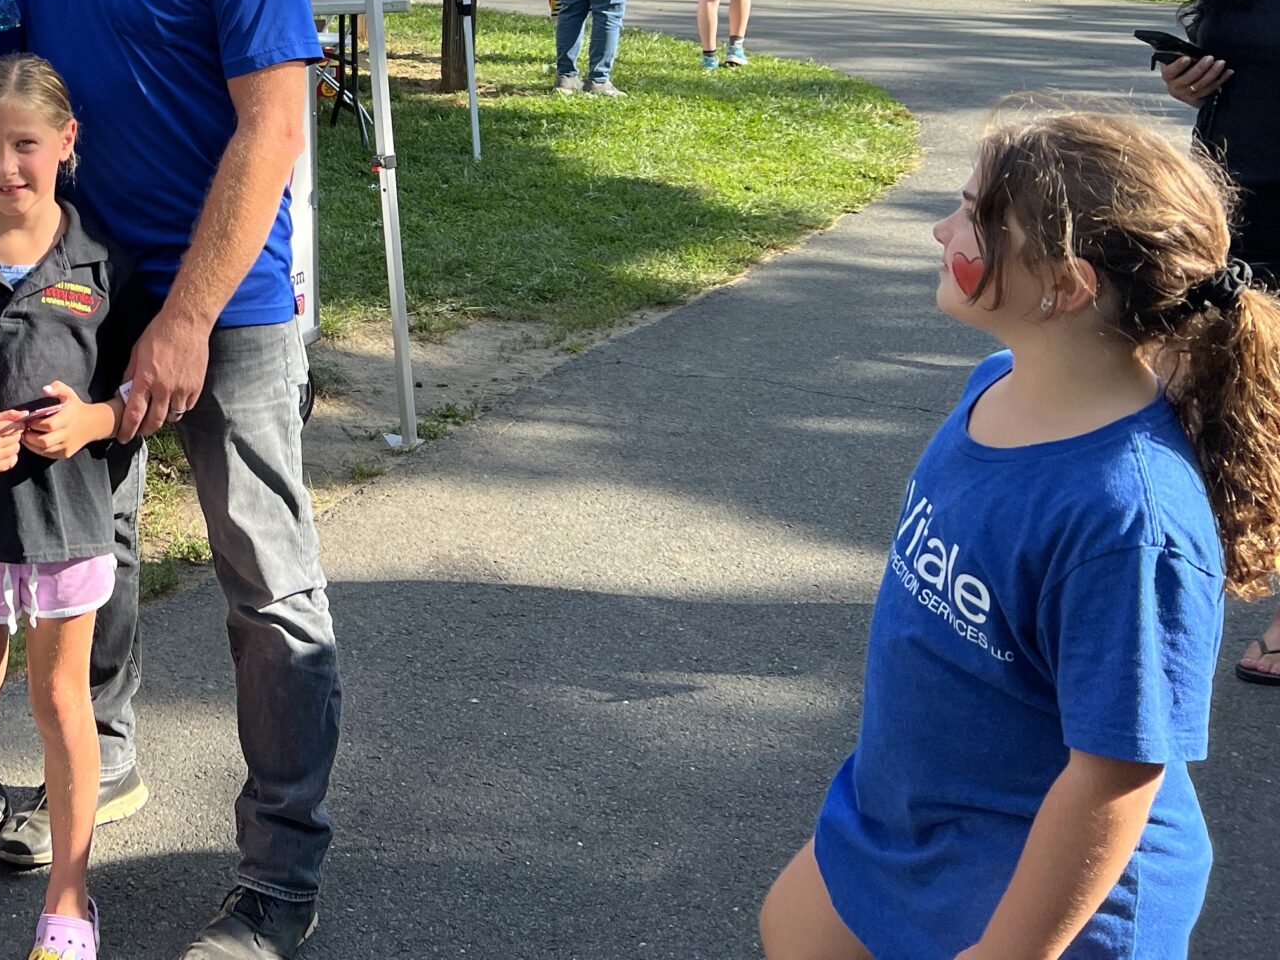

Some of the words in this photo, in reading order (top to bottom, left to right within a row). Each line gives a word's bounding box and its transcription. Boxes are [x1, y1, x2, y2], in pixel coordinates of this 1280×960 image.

[897, 480, 991, 624] Vitale
[917, 590, 988, 649] SERVICES
[991, 645, 1014, 662] LLC
